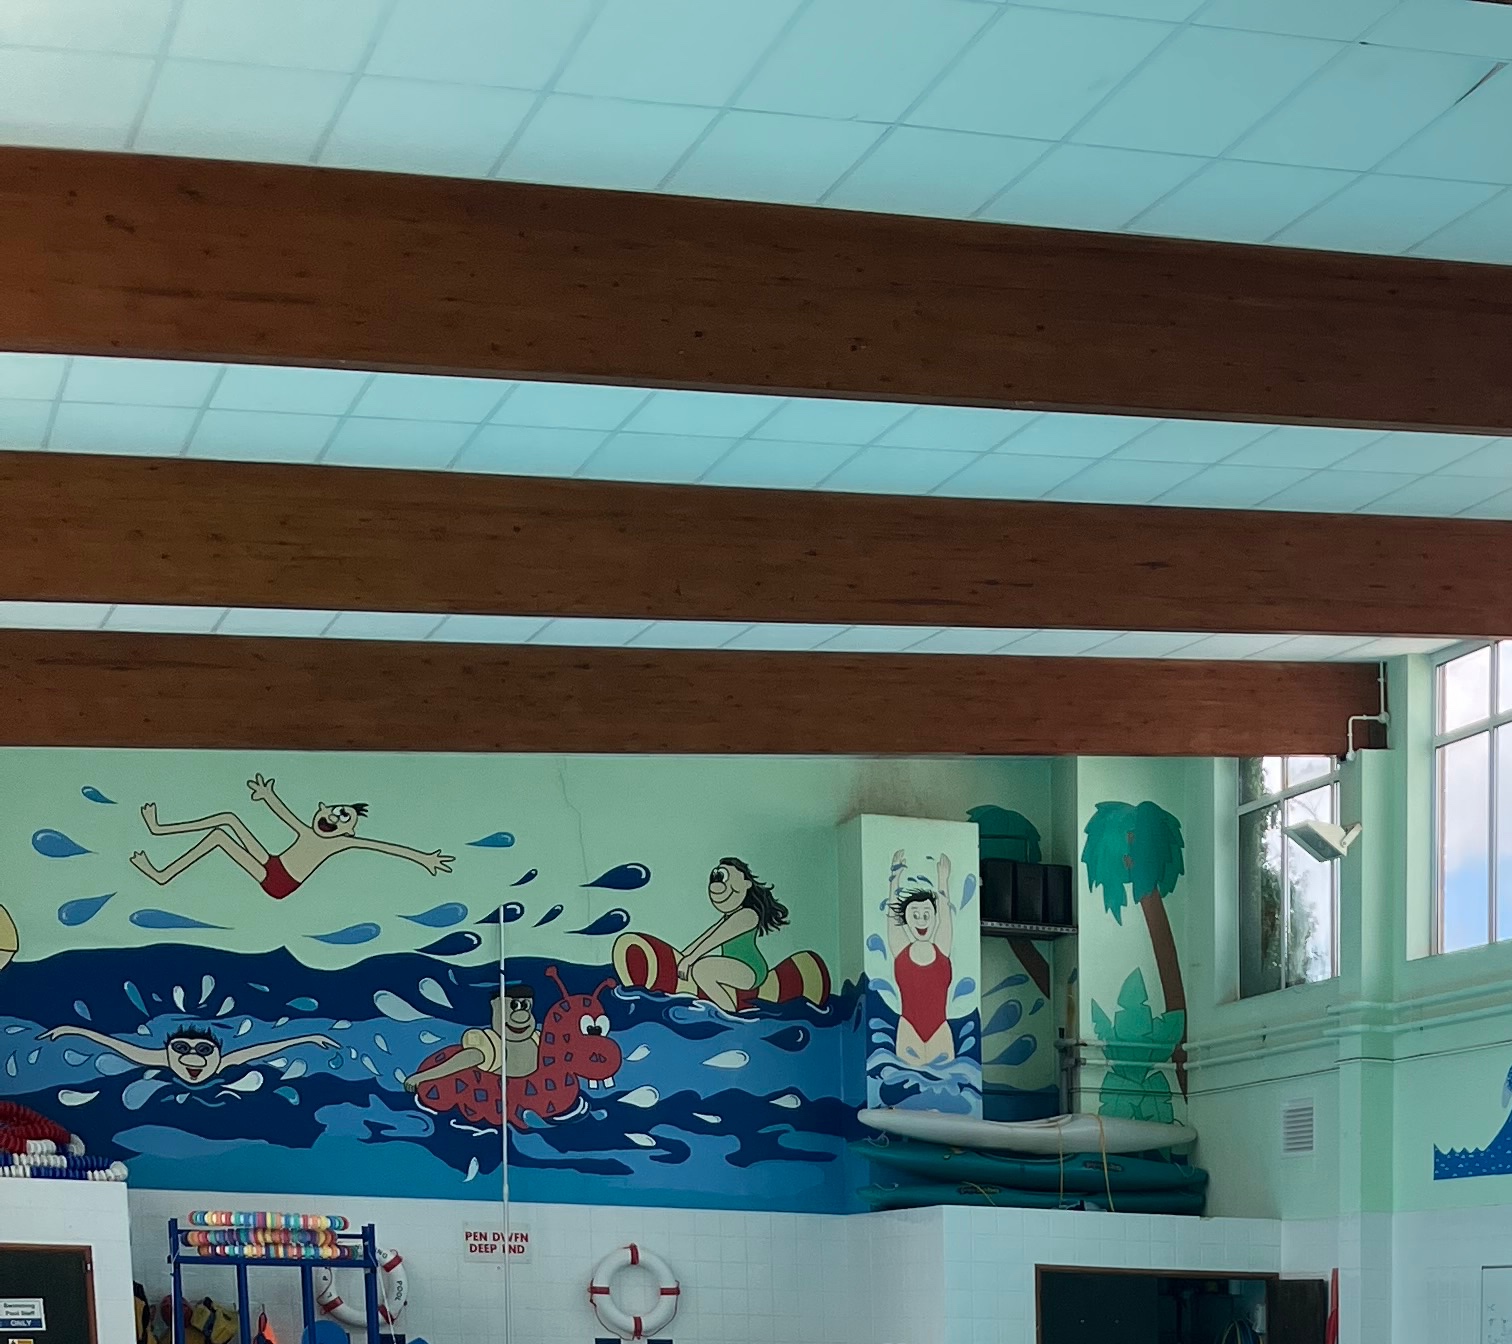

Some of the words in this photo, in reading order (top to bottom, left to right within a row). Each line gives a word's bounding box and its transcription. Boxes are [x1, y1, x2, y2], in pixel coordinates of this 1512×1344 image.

[465, 1231, 487, 1241] PEN
[469, 1244, 497, 1253] DEEP
[10, 1319, 32, 1327] ONLY
